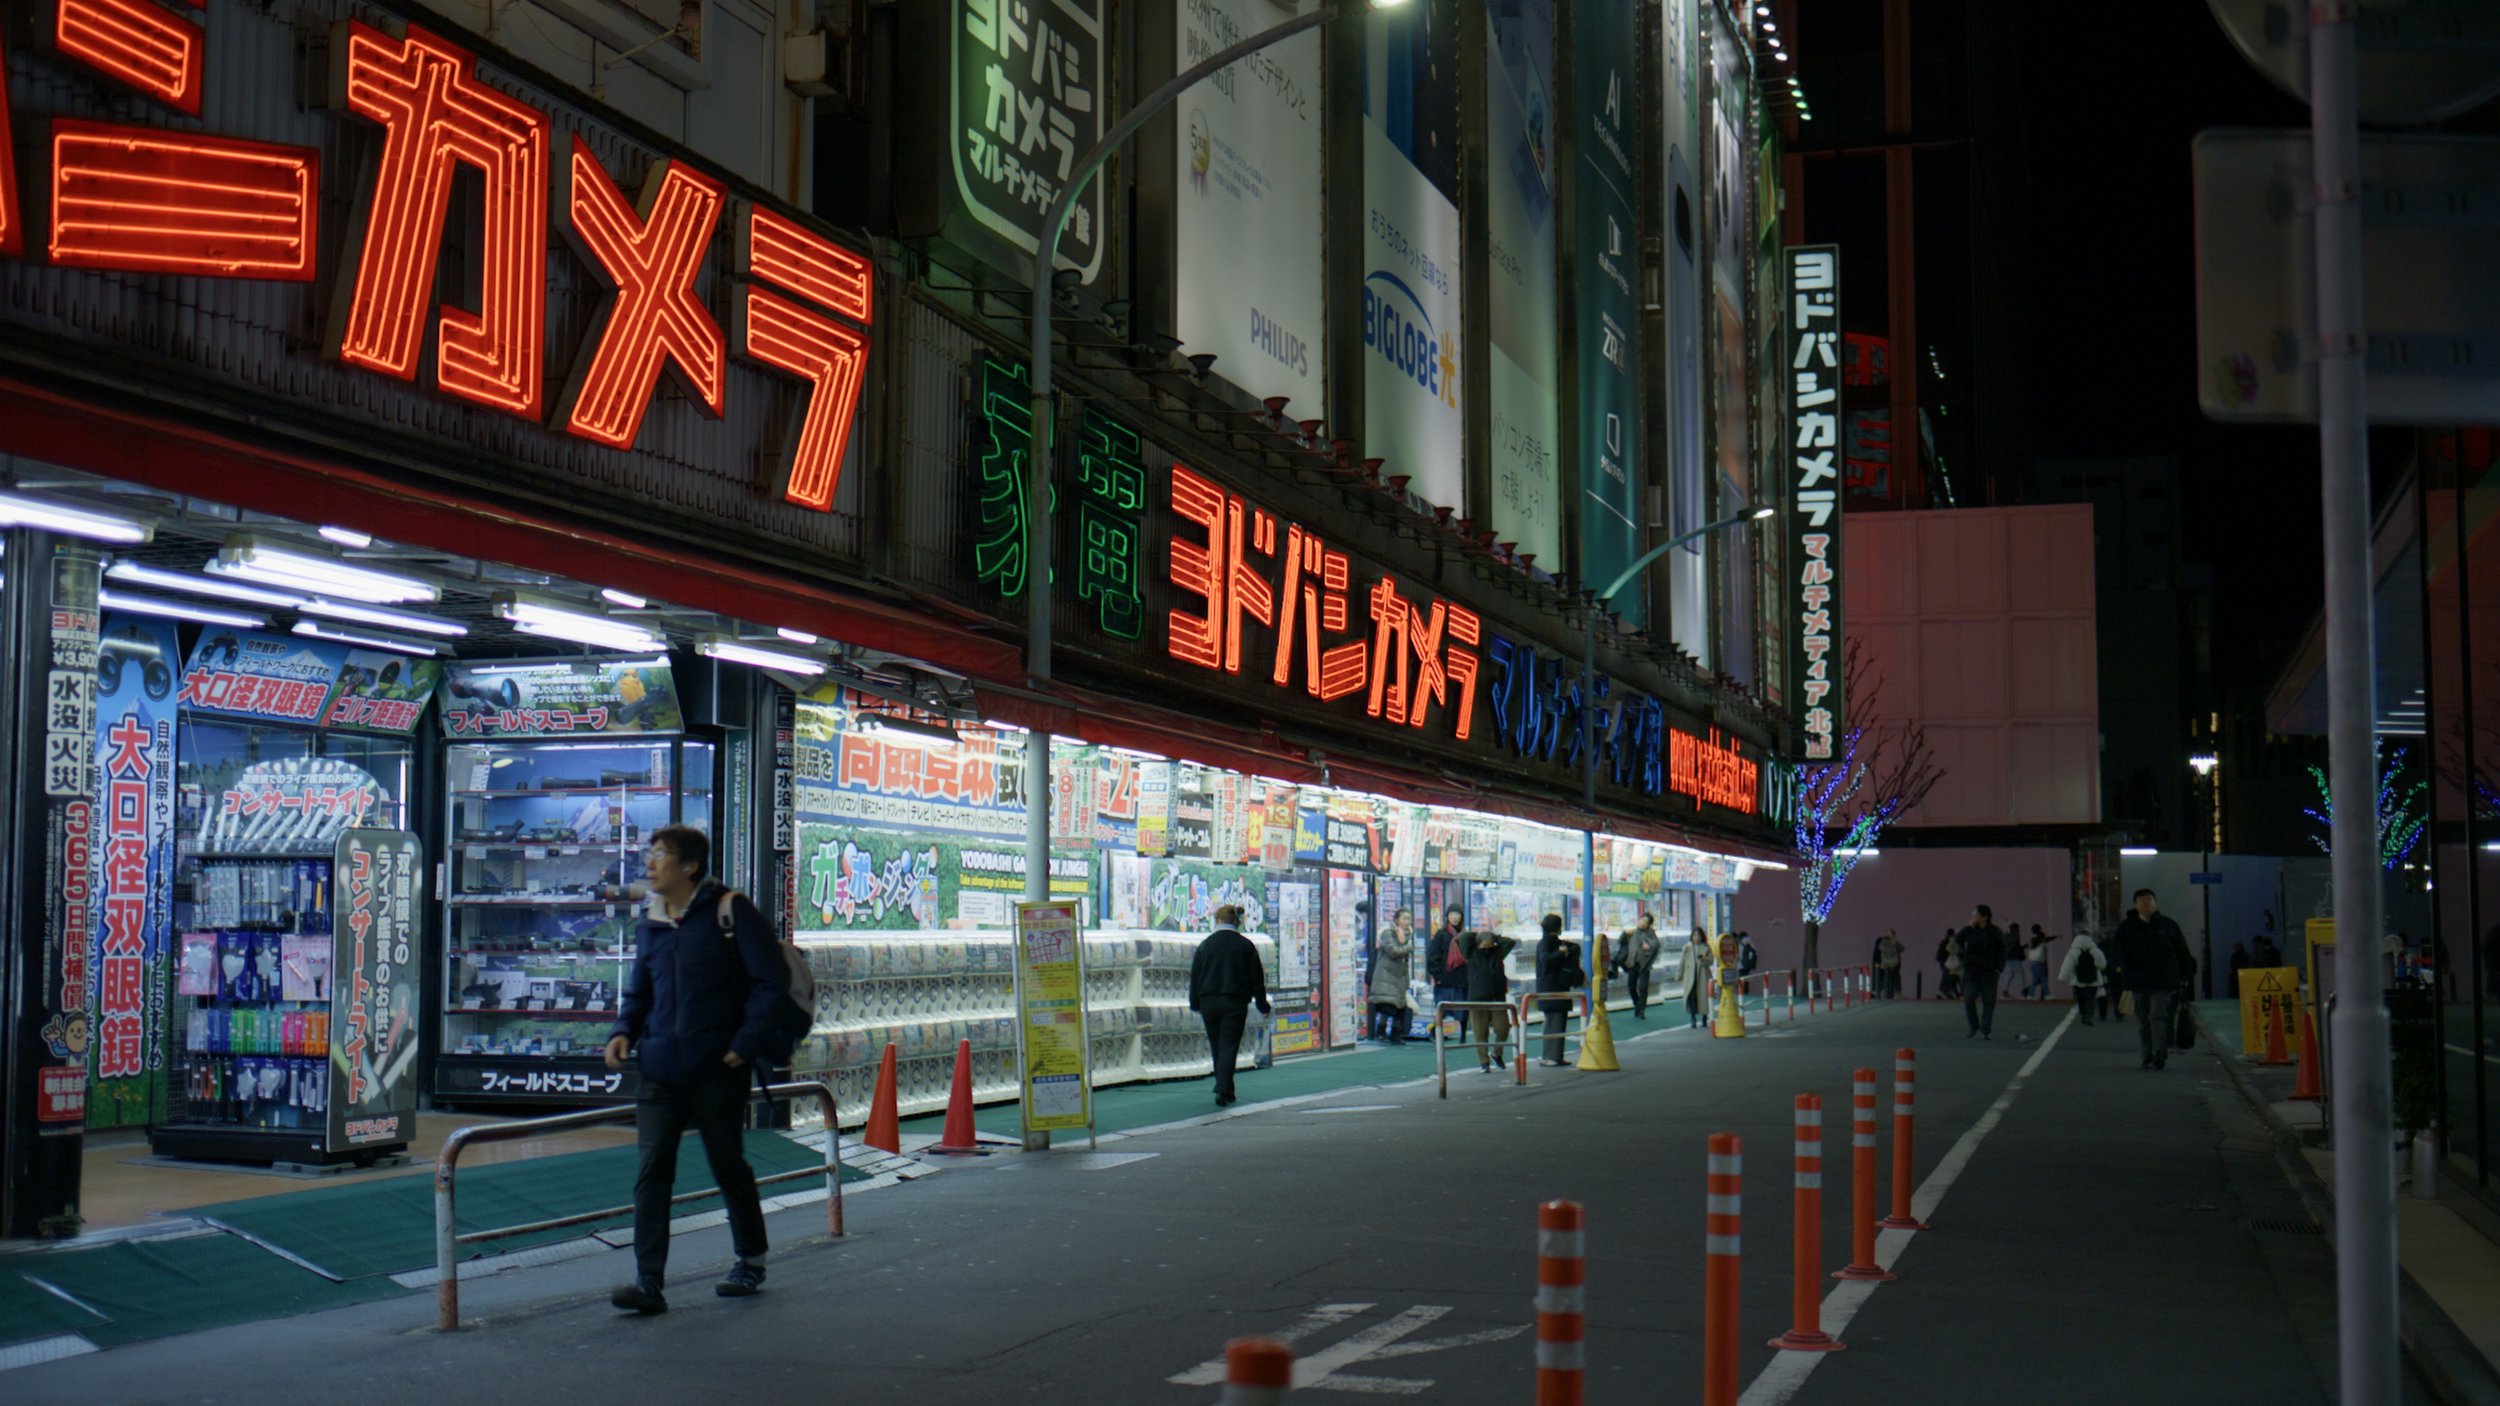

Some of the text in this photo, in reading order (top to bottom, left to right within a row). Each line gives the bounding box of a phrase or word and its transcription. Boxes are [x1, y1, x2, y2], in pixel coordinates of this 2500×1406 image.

[984, 63, 1076, 181] カメラ
[1605, 67, 1621, 131] AI
[0, 0, 874, 513] シカメラ
[1250, 306, 1309, 378] PHILIPS
[1793, 252, 1838, 526] ヨドバシカメラ
[1168, 462, 1480, 741] ヨドバシカメラ
[51, 674, 82, 731] 水没
[177, 666, 330, 719] 大口径双眼鏡
[331, 696, 421, 731] ゴルフ距離計
[448, 706, 610, 734] フィールドスコープ
[49, 736, 79, 792] 火災
[223, 785, 375, 817] コンサートライト
[910, 805, 931, 822] テレビ
[960, 850, 1012, 873] YODOBASHI
[1061, 858, 1089, 878] JUNGLE
[99, 714, 152, 1077] 大口径双眼鏡
[394, 852, 411, 966] 双眼鏡での
[345, 850, 372, 1105] コンサートライト
[480, 1071, 622, 1095] フィールドスコープ
